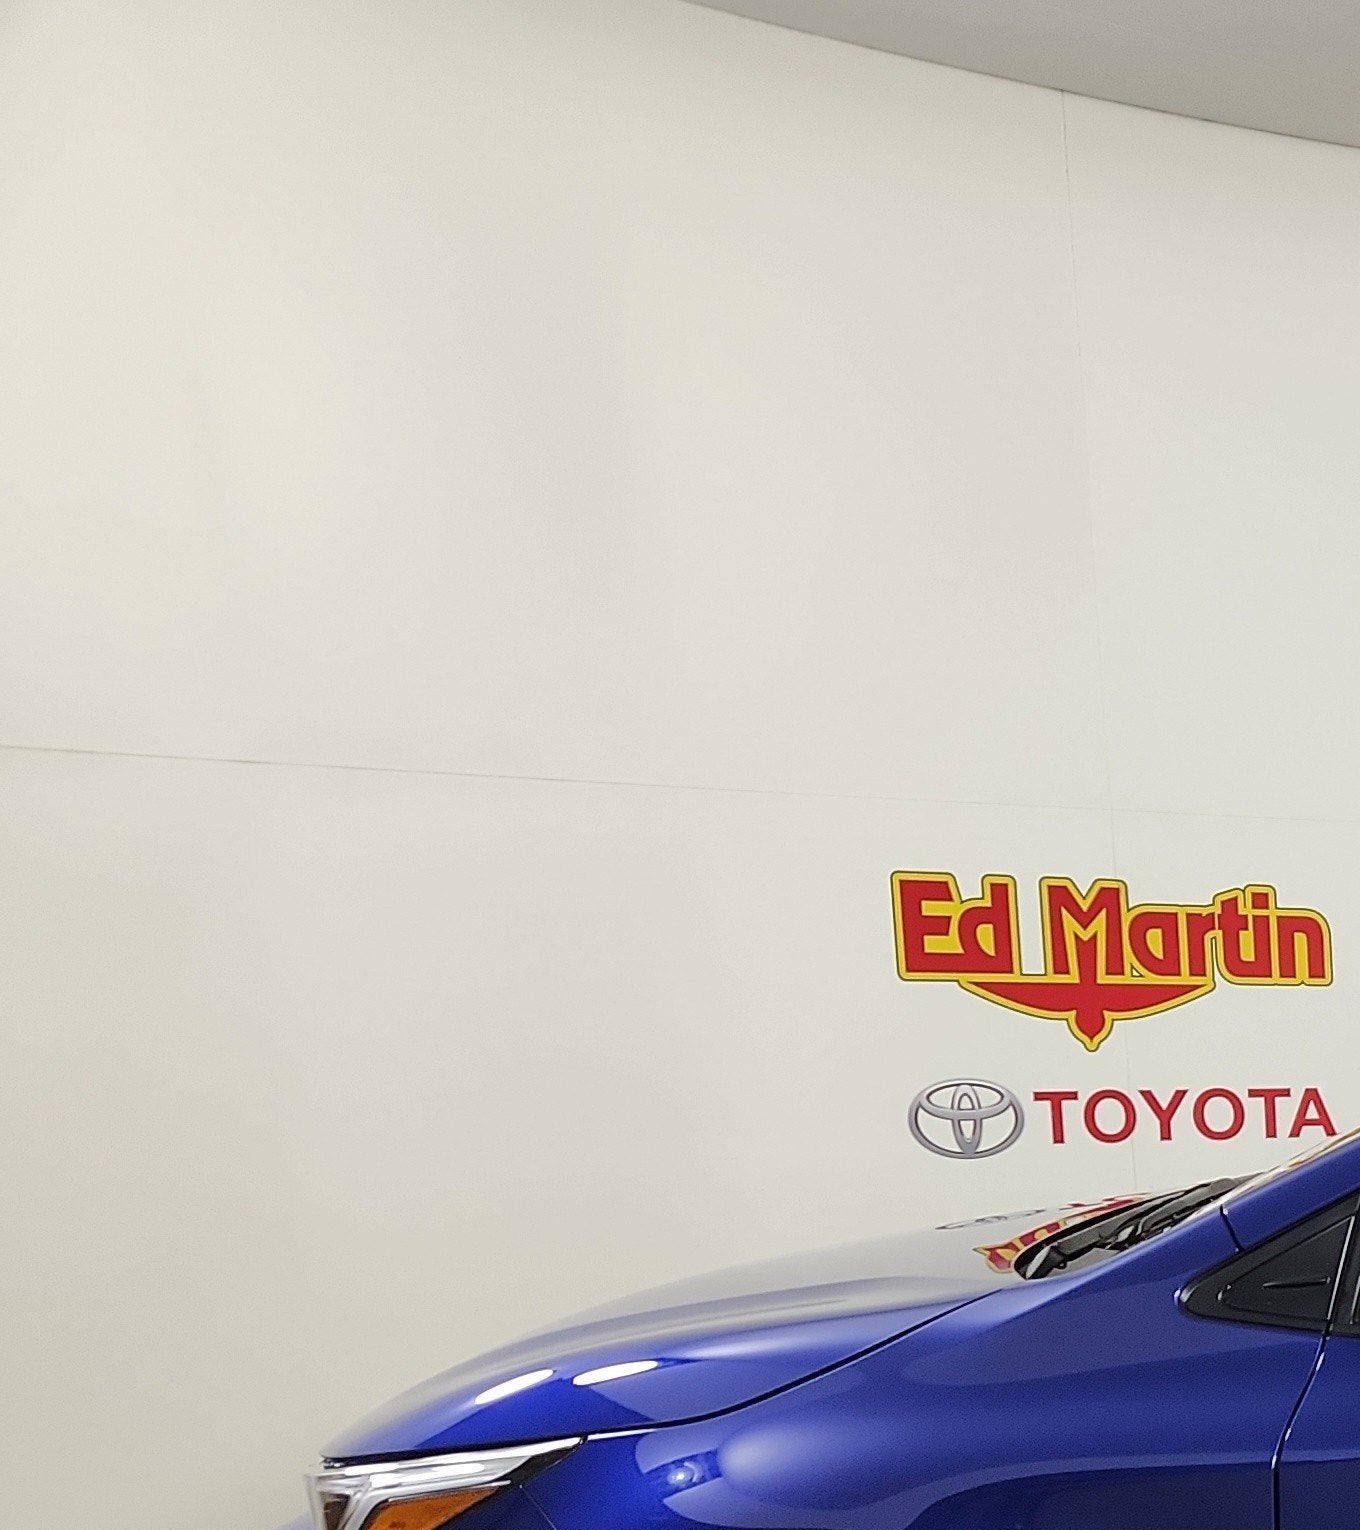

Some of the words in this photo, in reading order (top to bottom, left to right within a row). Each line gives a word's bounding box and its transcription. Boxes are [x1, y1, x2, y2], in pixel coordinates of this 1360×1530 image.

[896, 876, 1016, 976] Ed
[1040, 876, 1331, 984] Martin
[1033, 1087, 1337, 1144] TOYOTA
